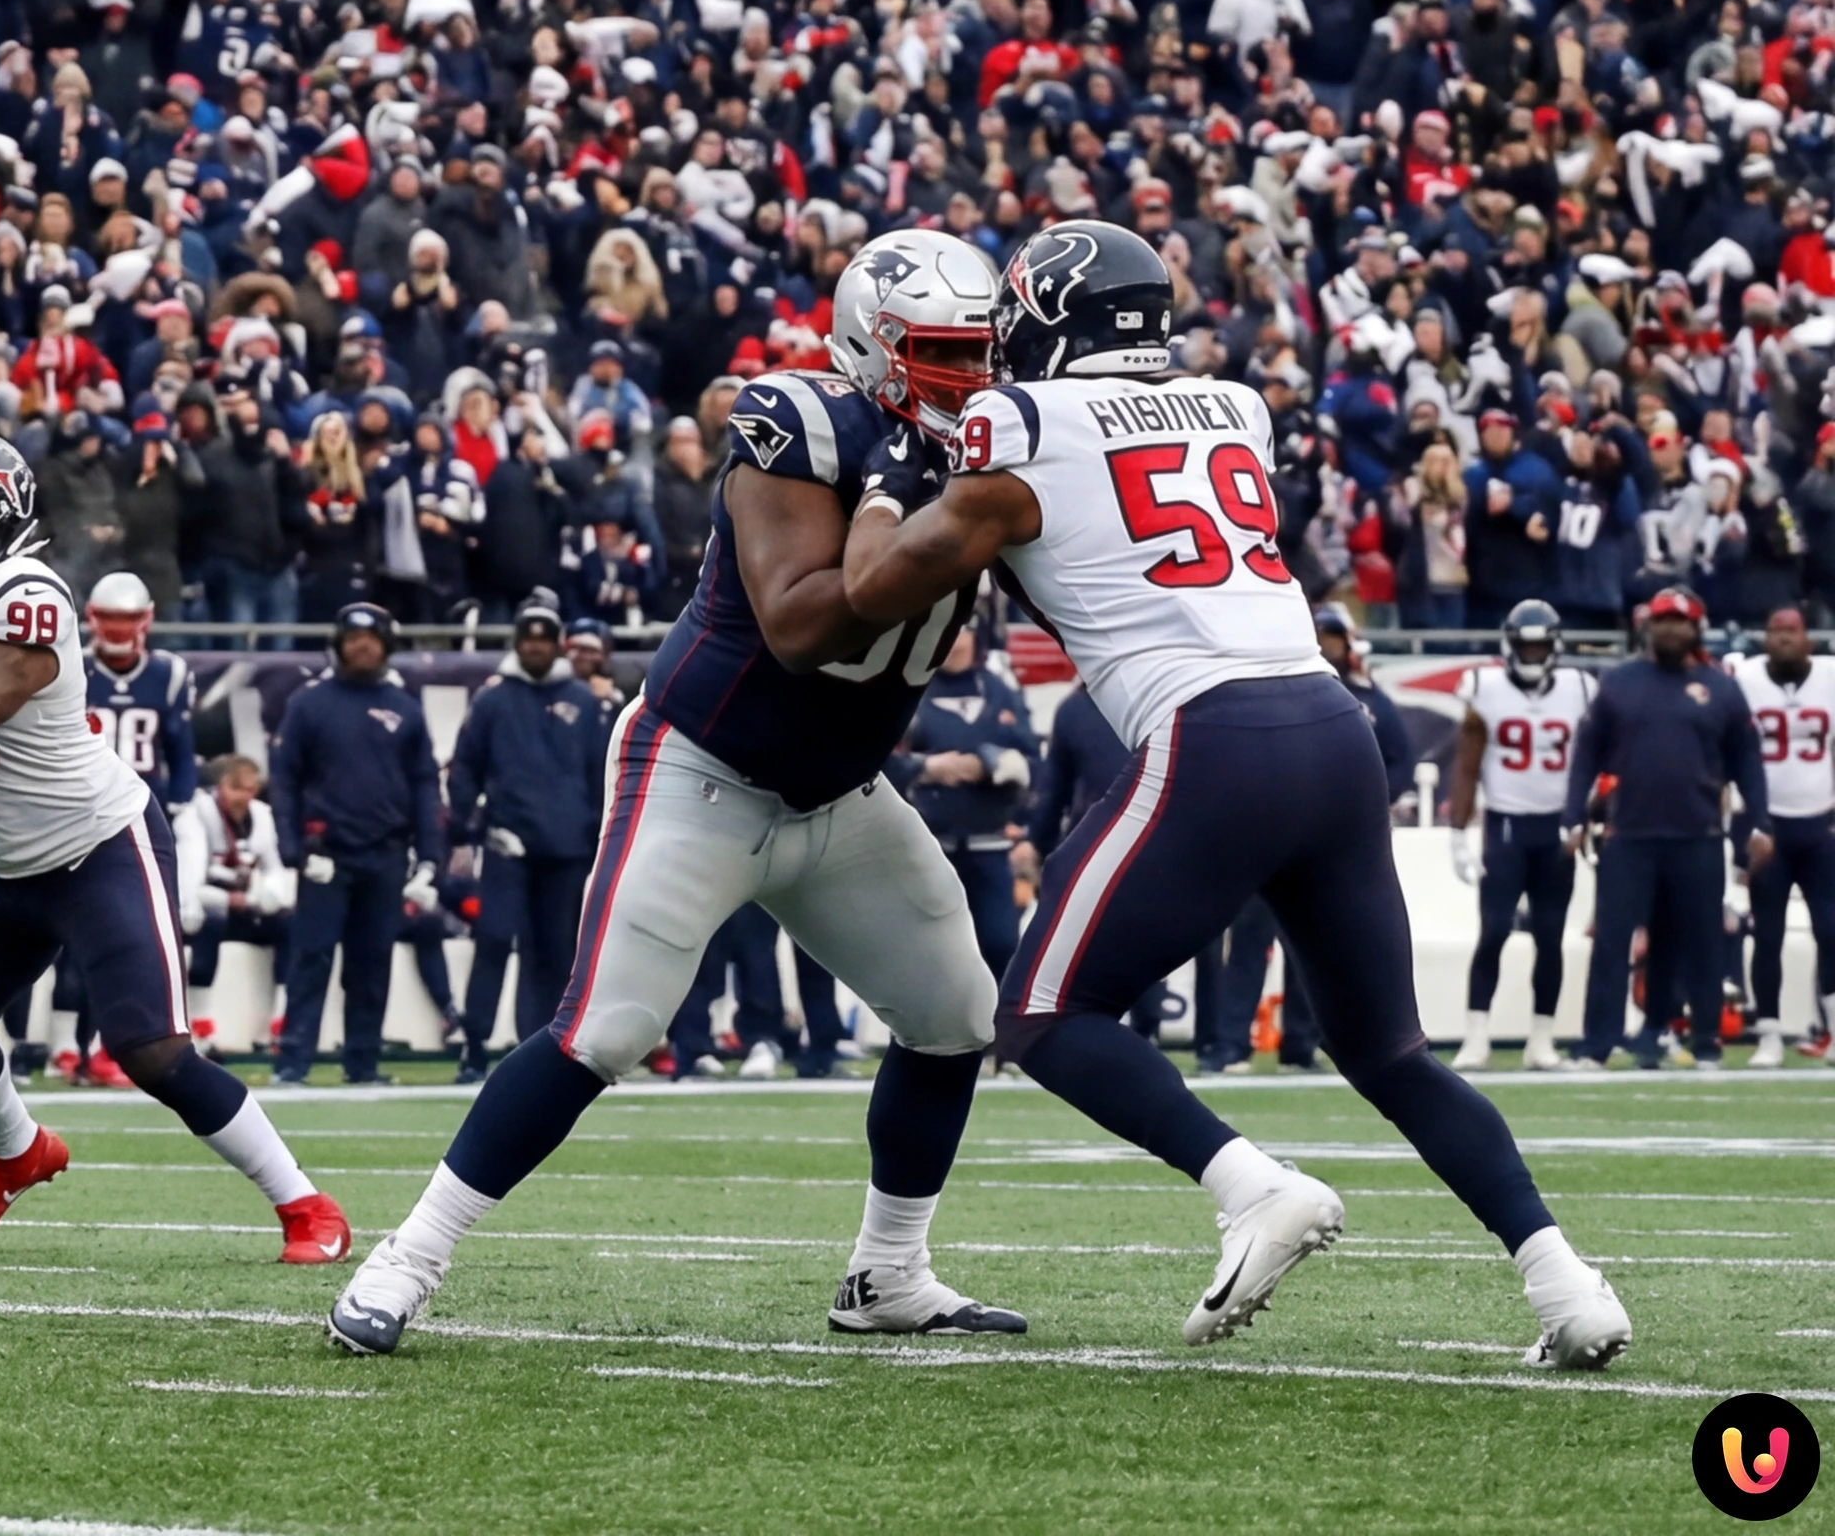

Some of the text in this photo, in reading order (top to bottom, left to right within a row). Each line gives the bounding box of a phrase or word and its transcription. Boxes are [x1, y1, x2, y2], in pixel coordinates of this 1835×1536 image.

[1106, 441, 1292, 589] 59
[7, 602, 58, 645] 98
[1496, 719, 1571, 772] 93
